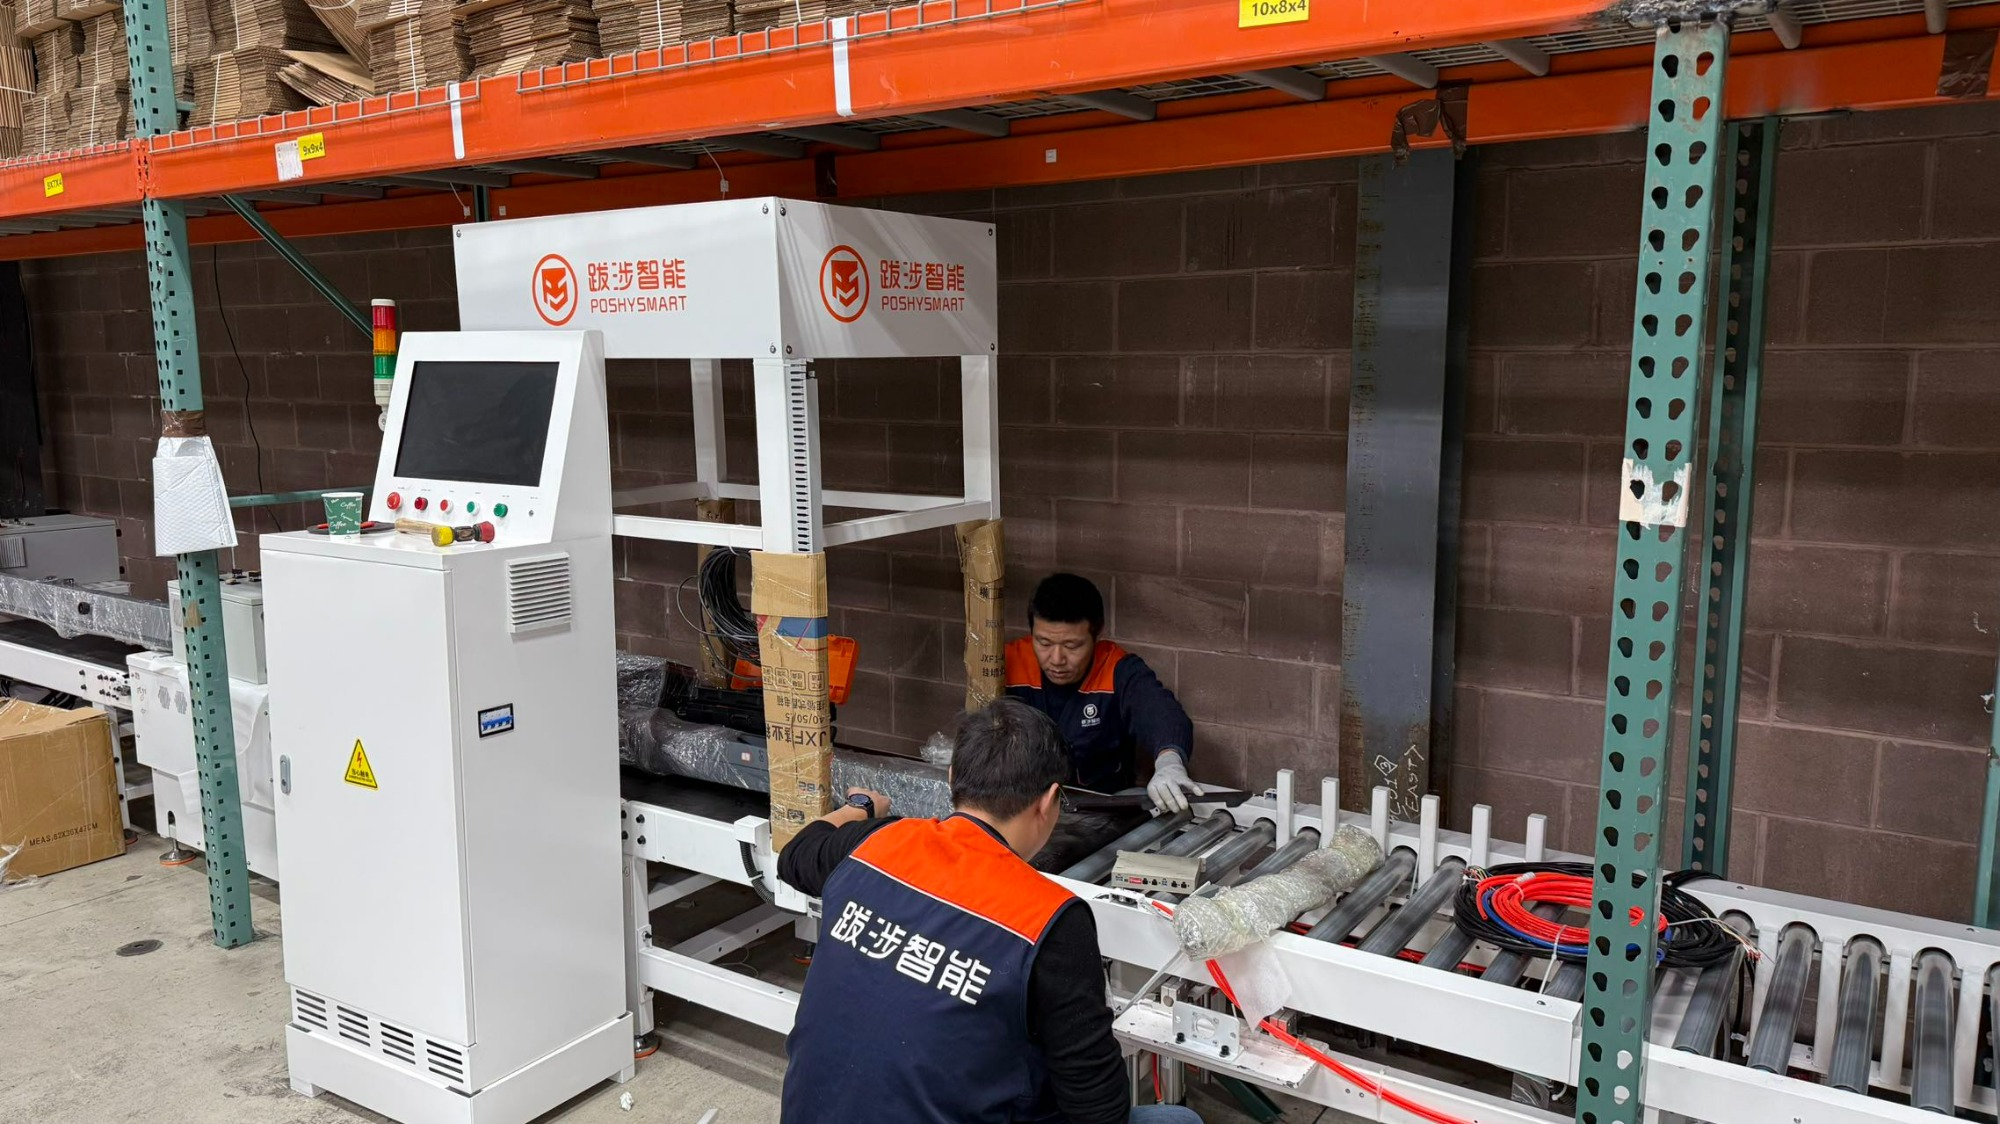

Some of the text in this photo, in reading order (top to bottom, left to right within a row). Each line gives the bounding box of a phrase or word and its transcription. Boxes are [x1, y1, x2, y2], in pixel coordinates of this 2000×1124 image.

[1252, 0, 1307, 17] 10x8x4
[587, 258, 687, 292] 跋涉智能
[879, 259, 965, 292] 跋涉智能
[590, 295, 687, 313] POSHYSMART
[881, 295, 965, 312] POSHYSMART
[830, 900, 992, 1005] 跋涉智能
